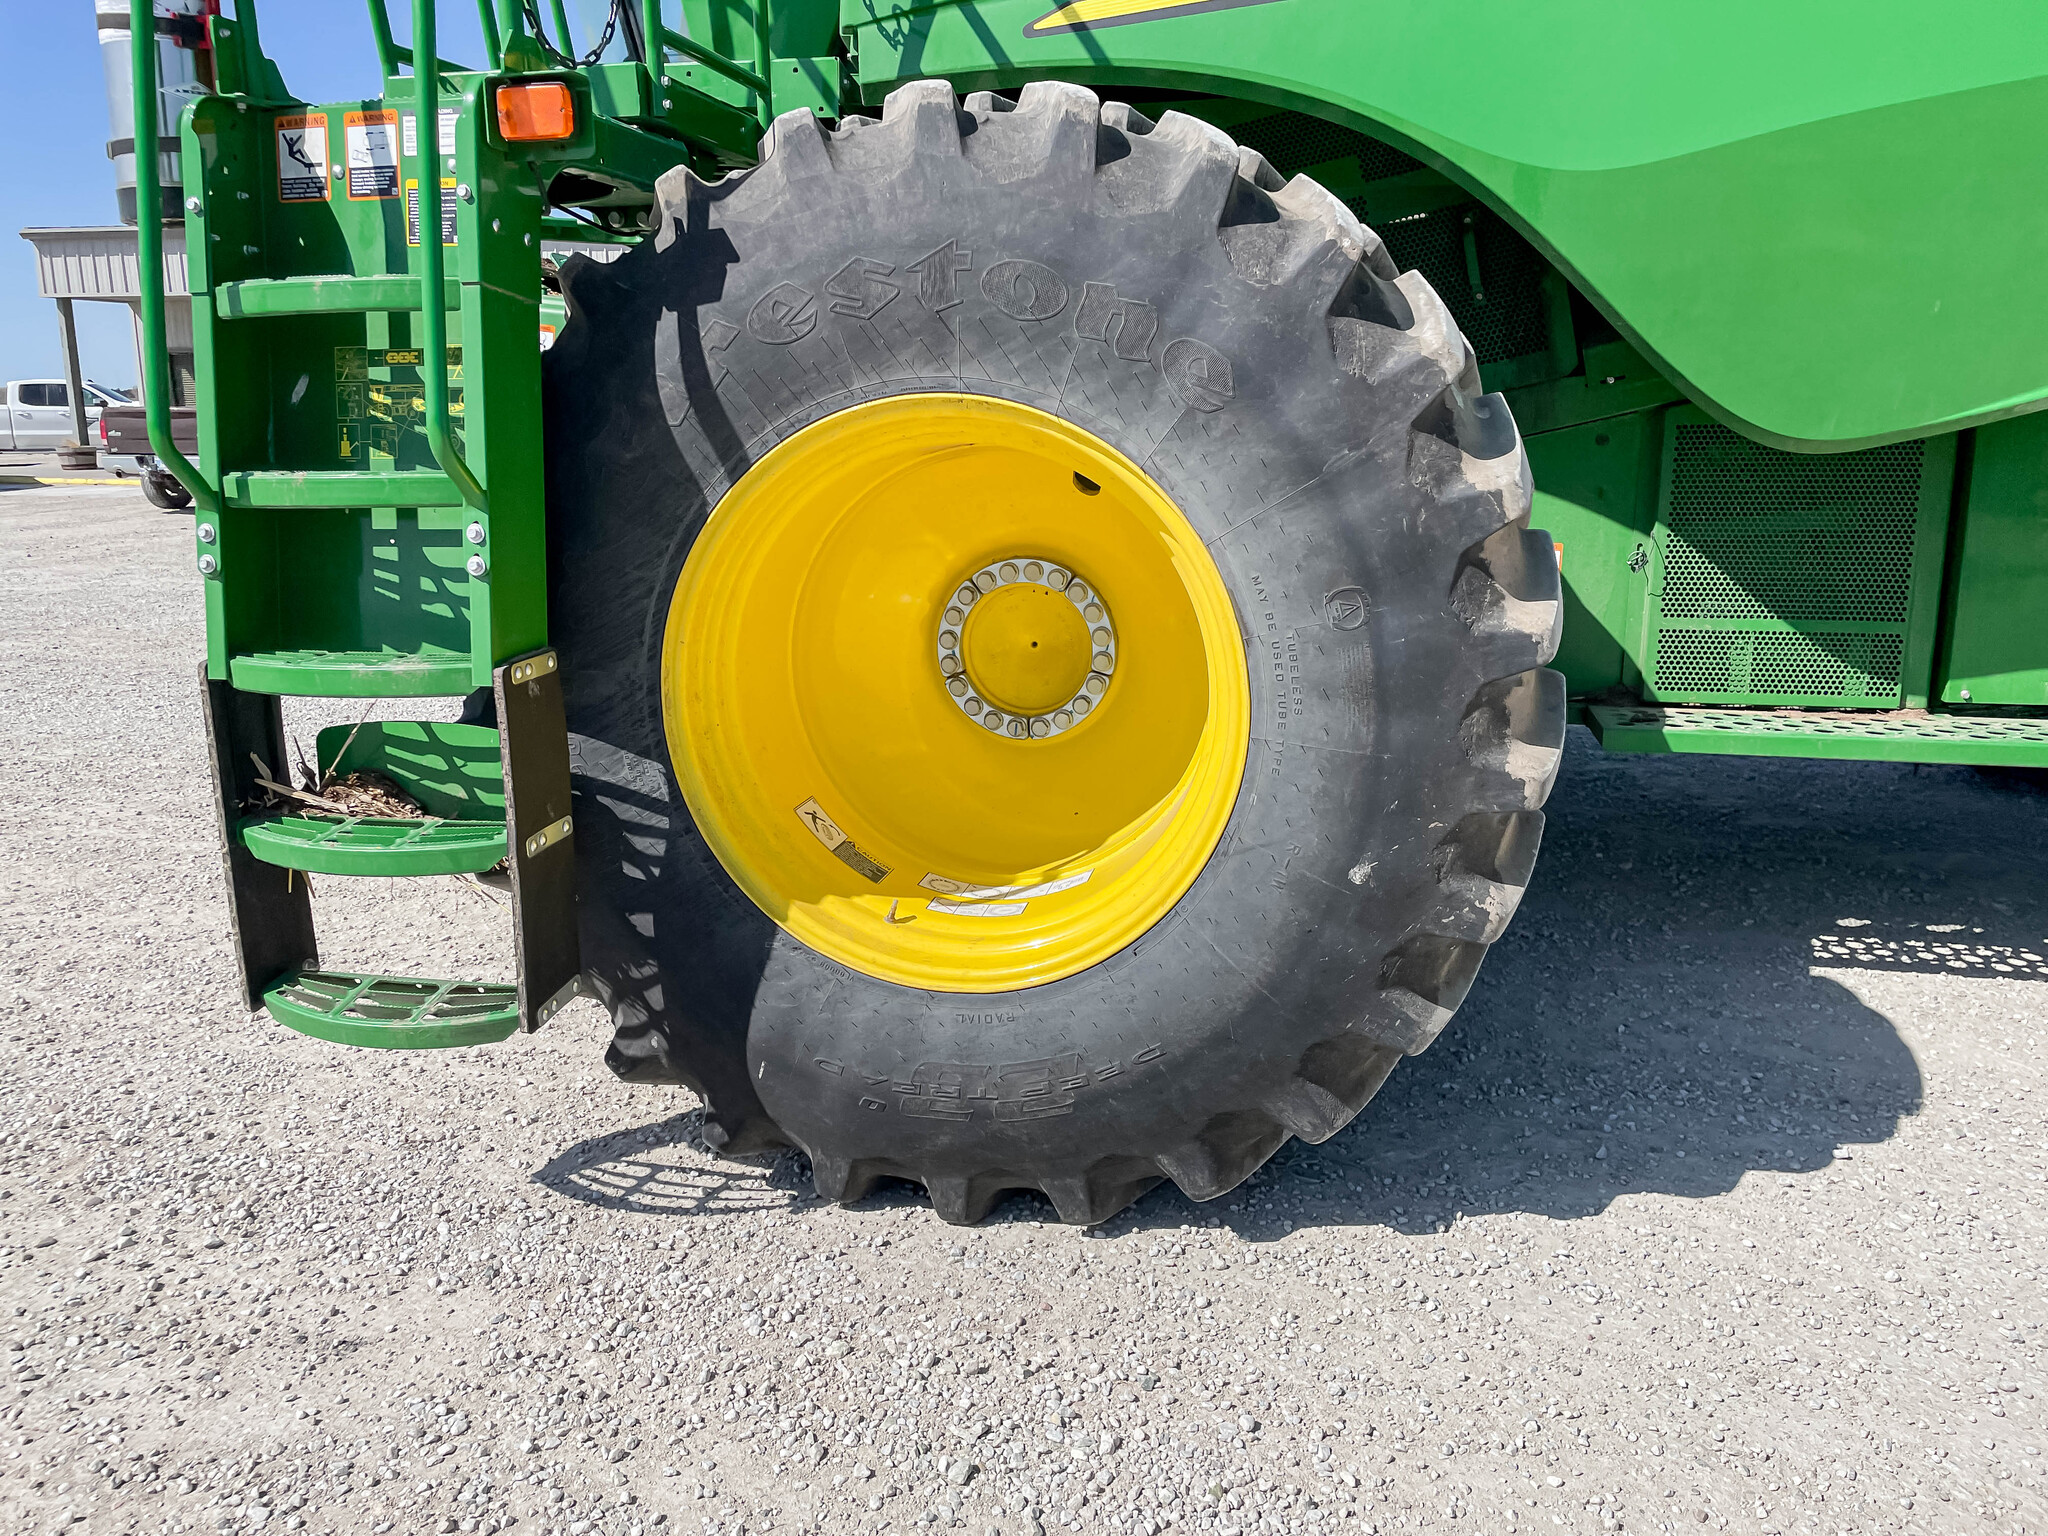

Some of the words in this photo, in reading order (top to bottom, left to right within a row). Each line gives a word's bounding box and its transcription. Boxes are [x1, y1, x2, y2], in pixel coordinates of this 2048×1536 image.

[285, 115, 325, 129] WARNING
[357, 113, 394, 123] WARNING
[1250, 573, 1269, 604] MAY
[1264, 611, 1277, 632] BE
[1271, 640, 1285, 683] USED
[1285, 633, 1303, 717] TUBELESS
[1277, 691, 1287, 730] TUBE
[1270, 739, 1285, 777] TYPE
[856, 846, 893, 872] CAUTION
[954, 1012, 1016, 1025] RADIAL
